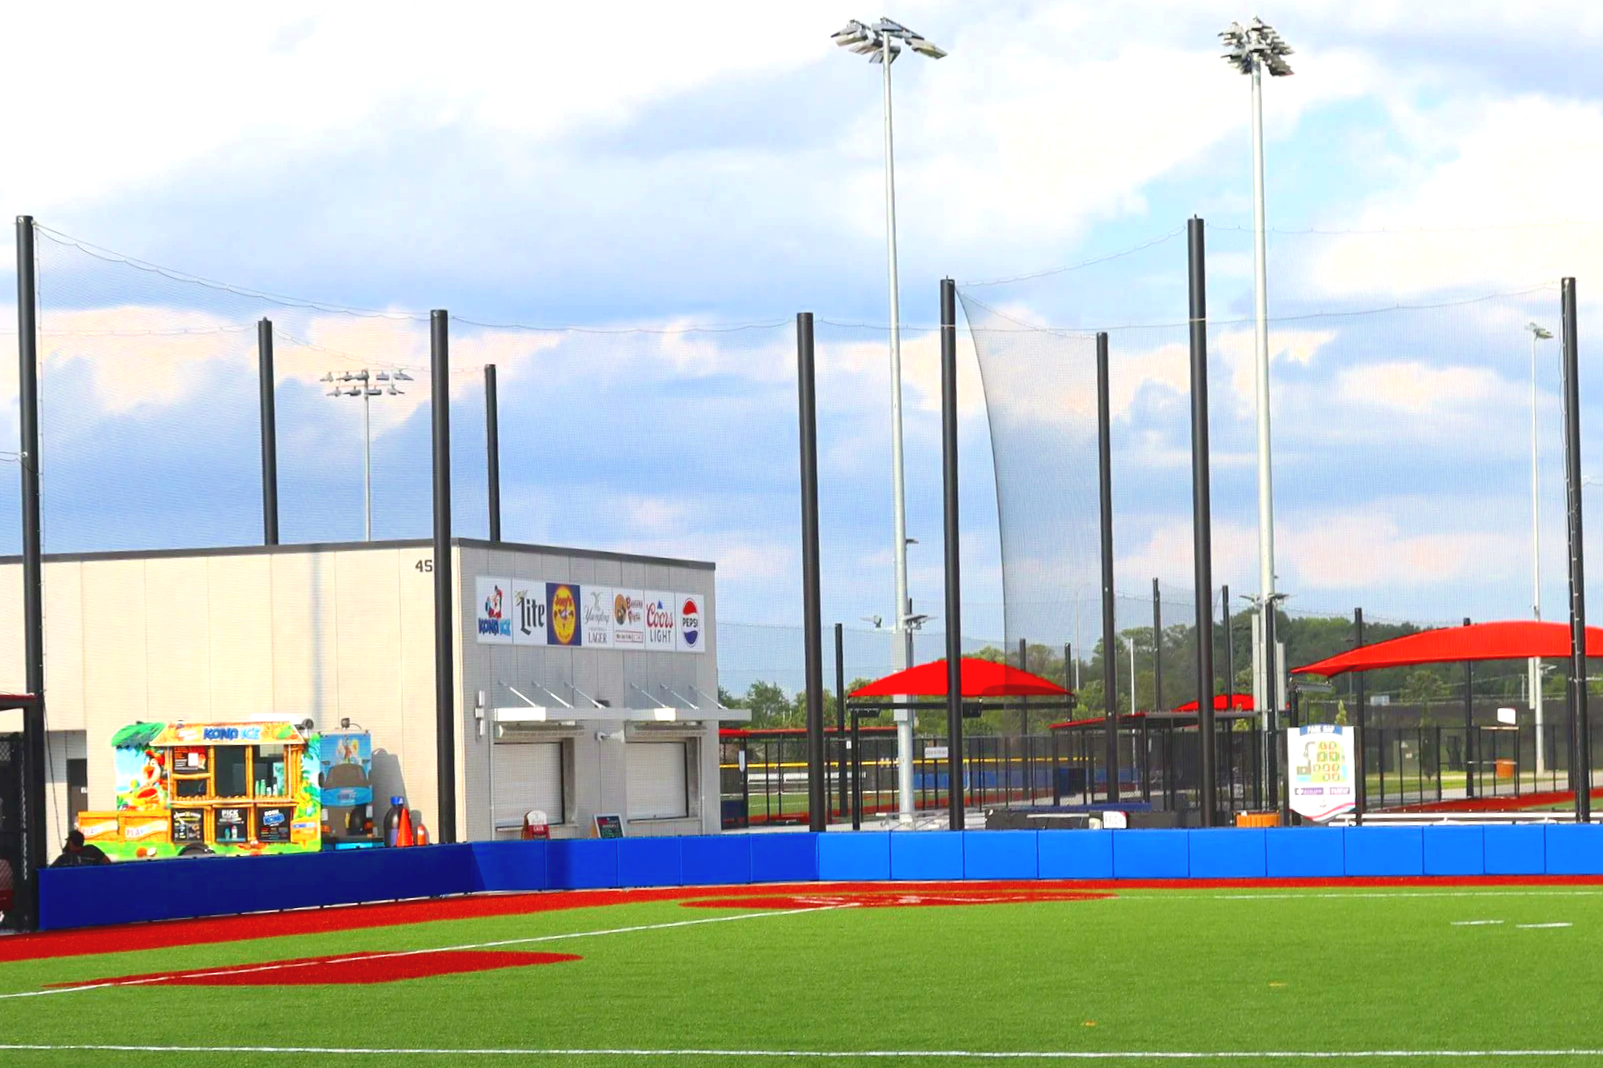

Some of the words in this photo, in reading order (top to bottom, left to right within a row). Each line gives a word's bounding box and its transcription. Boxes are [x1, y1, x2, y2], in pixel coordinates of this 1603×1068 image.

[415, 559, 433, 573] 45
[516, 597, 545, 636] Lite
[646, 602, 674, 629] Coors
[478, 618, 500, 636] KONA
[682, 618, 699, 628] PEPSI
[588, 632, 608, 644] LAGER
[650, 630, 672, 644] LIGHT
[203, 727, 239, 740] KONA
[239, 727, 260, 740] ICE
[221, 809, 239, 818] PICK
